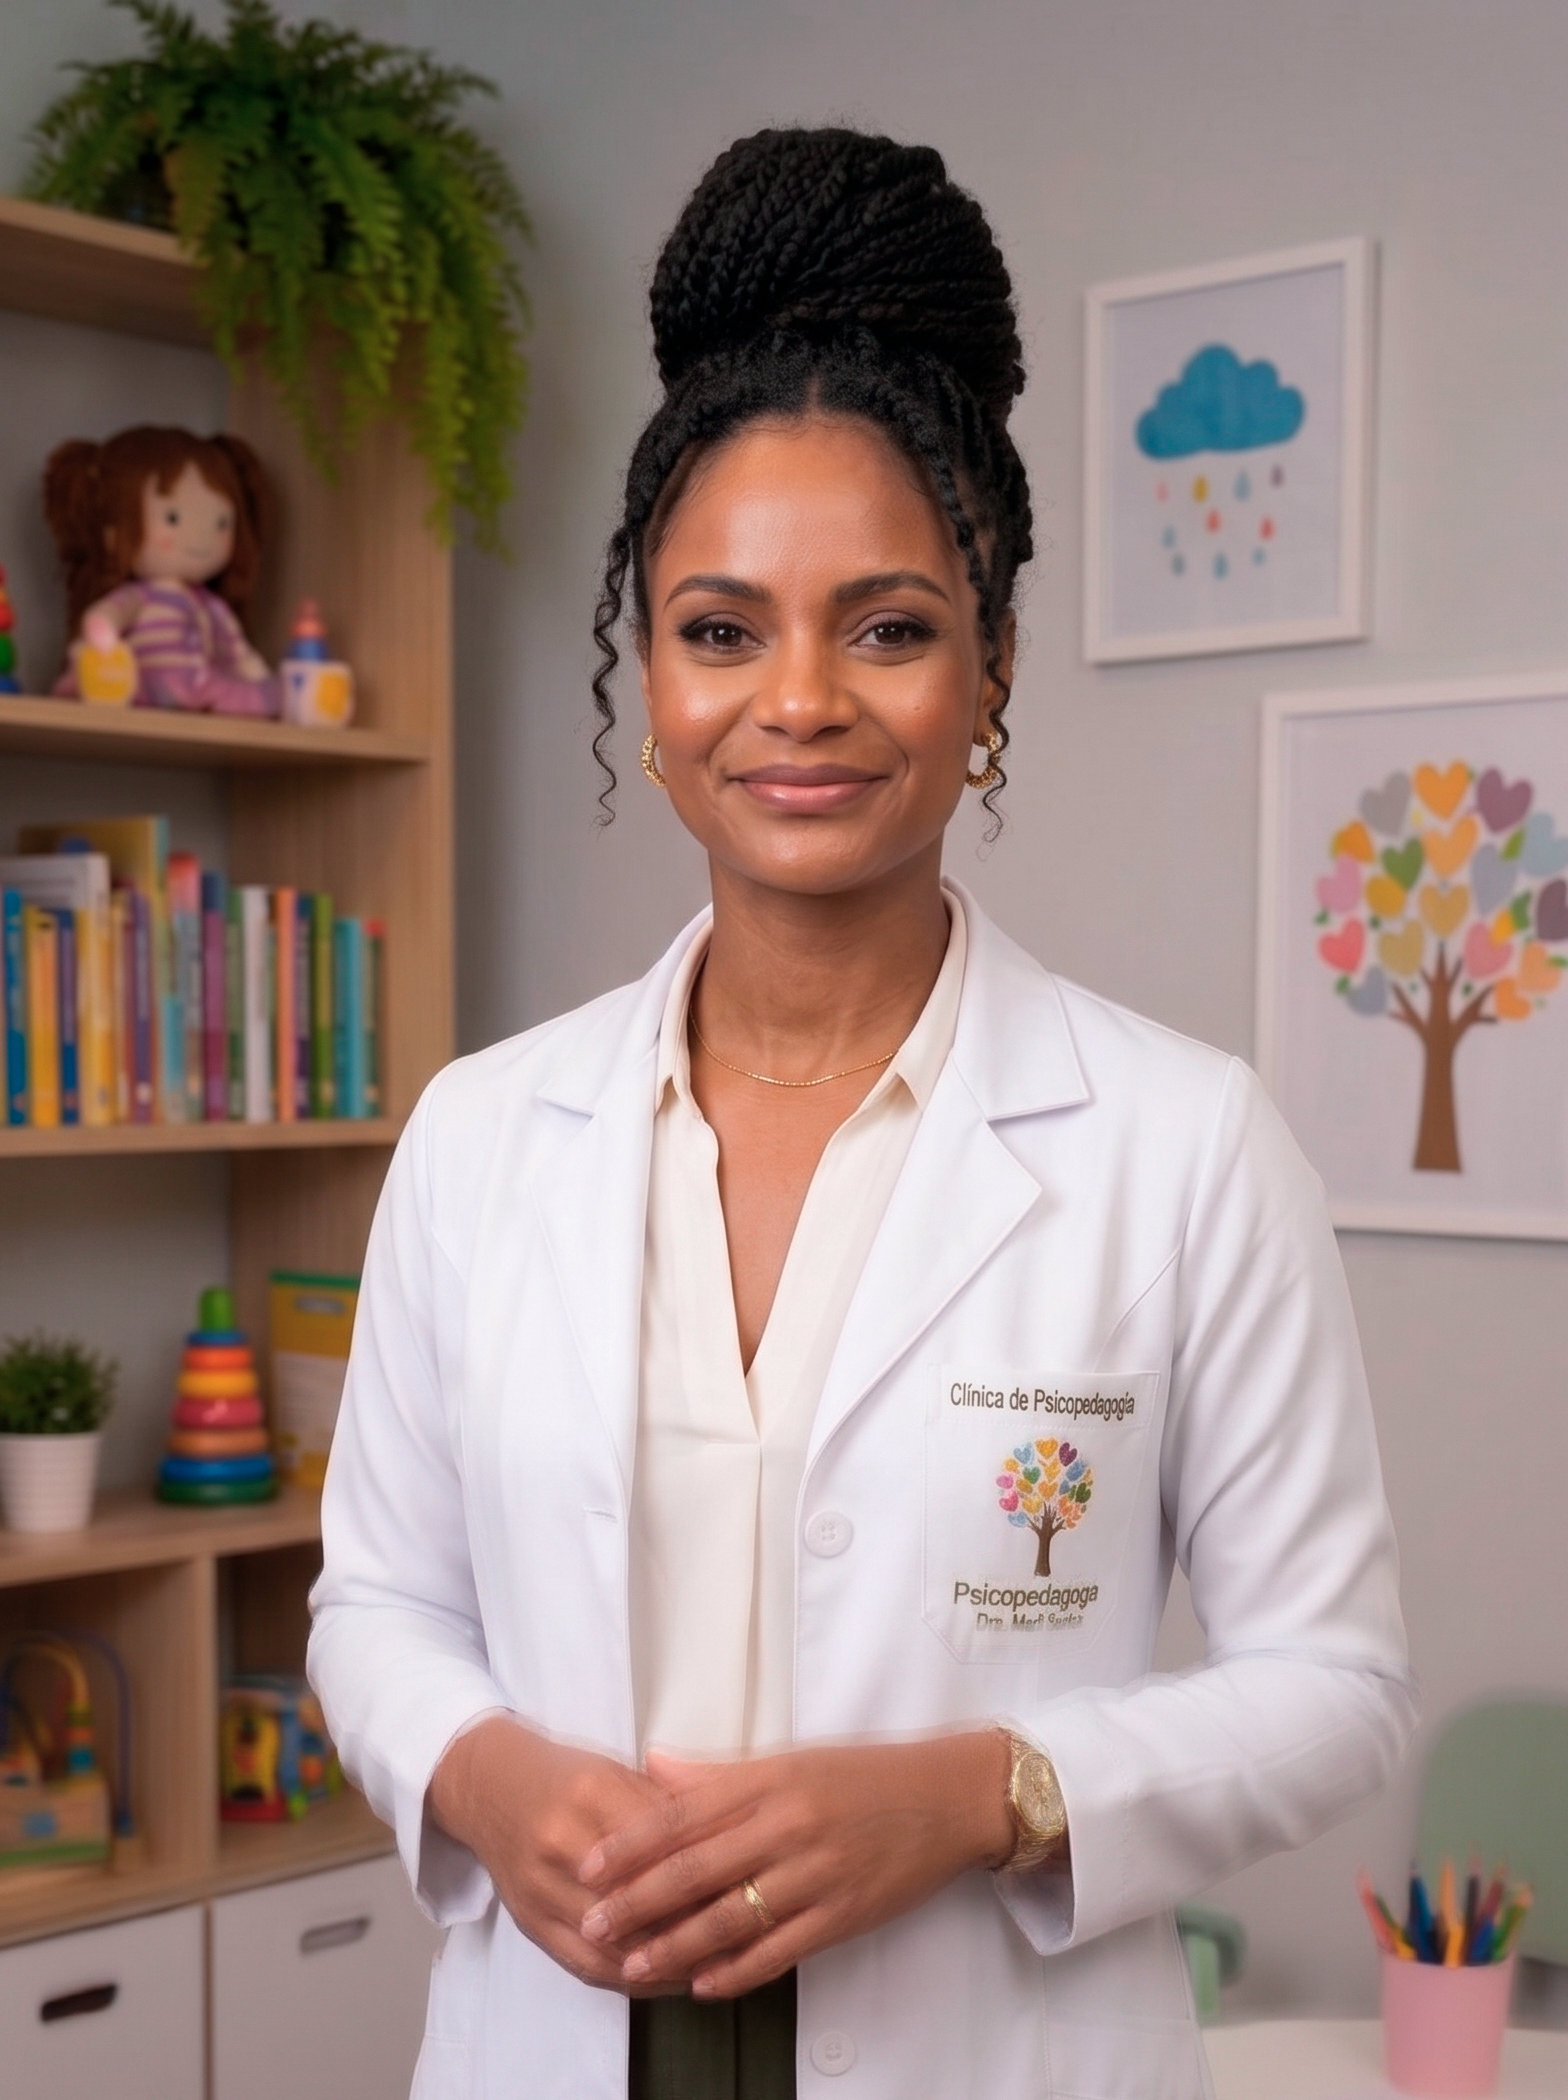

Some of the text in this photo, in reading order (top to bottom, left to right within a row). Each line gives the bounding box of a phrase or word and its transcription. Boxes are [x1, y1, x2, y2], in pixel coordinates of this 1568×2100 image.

[950, 1383, 1004, 1409] Clínica
[1009, 1387, 1029, 1411] de
[953, 1581, 1099, 1612] Psicopedagoga
